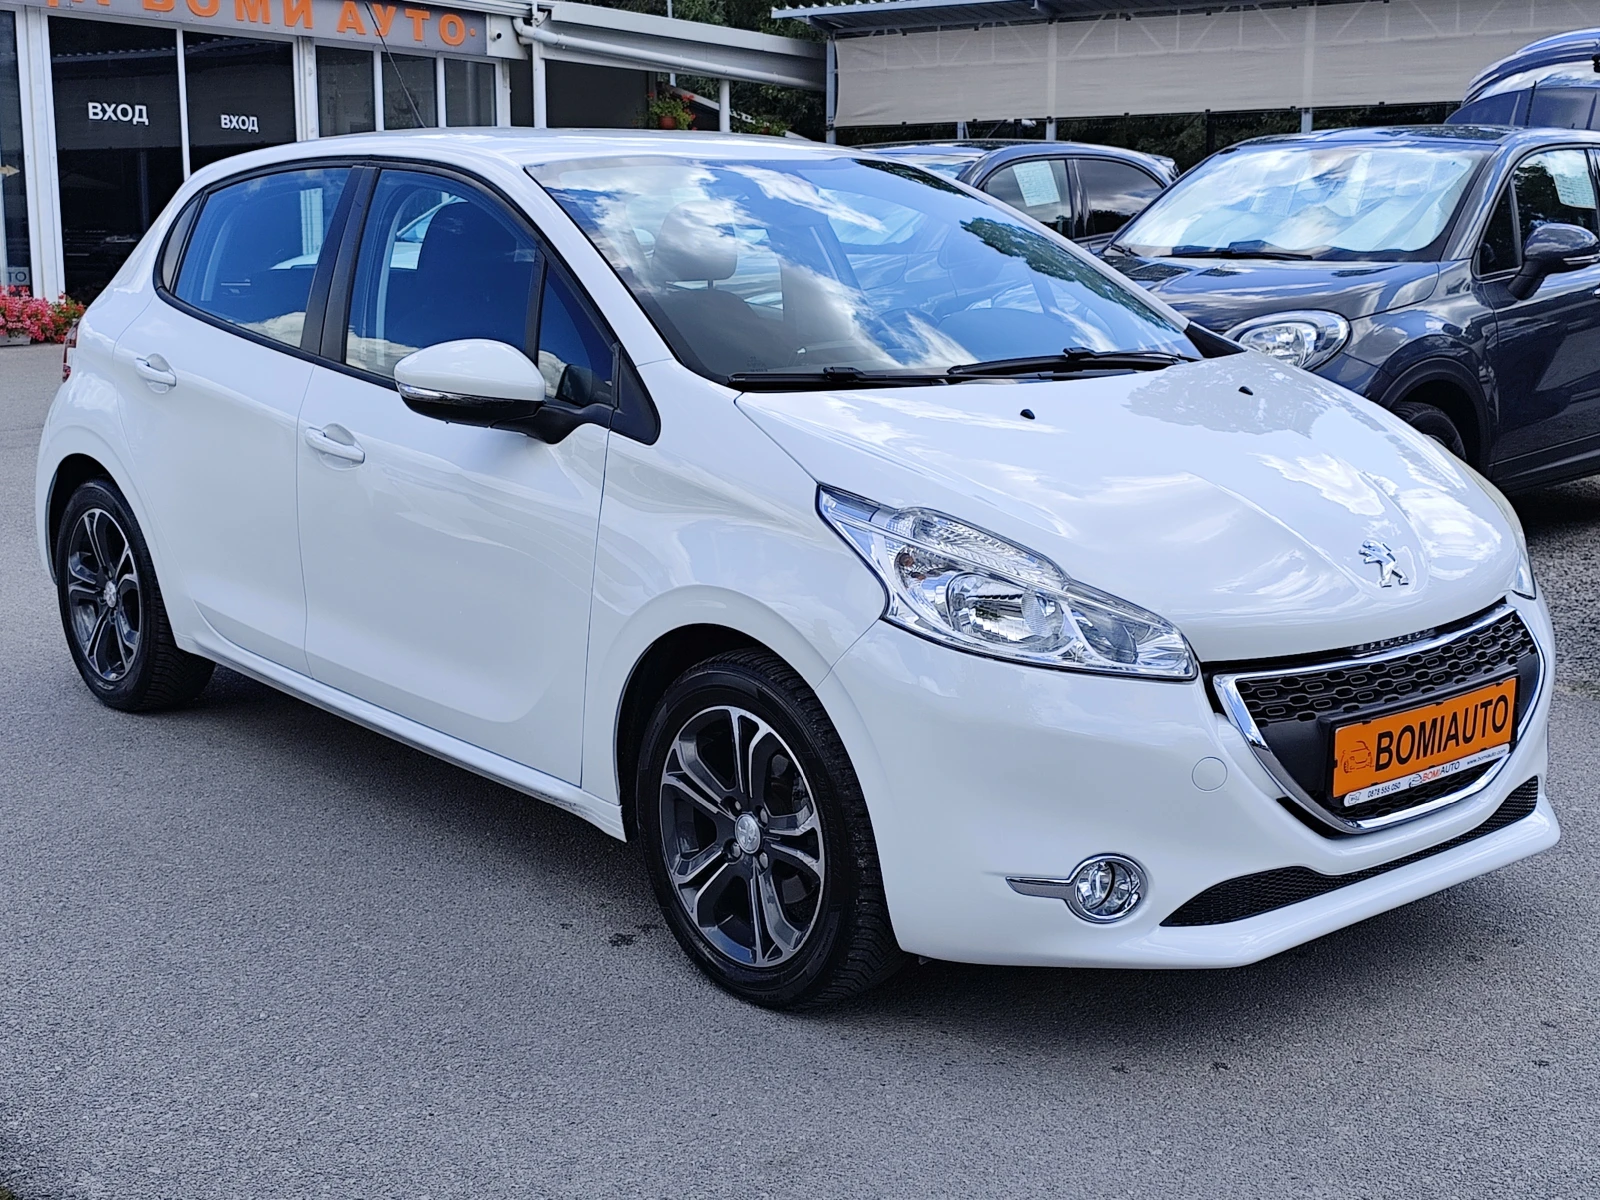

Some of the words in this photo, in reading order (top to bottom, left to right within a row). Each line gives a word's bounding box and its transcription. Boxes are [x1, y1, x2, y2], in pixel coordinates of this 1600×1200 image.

[88, 102, 149, 125] ВХОД
[220, 114, 259, 133] ВХОД
[1374, 694, 1509, 772] BOMIAUTO
